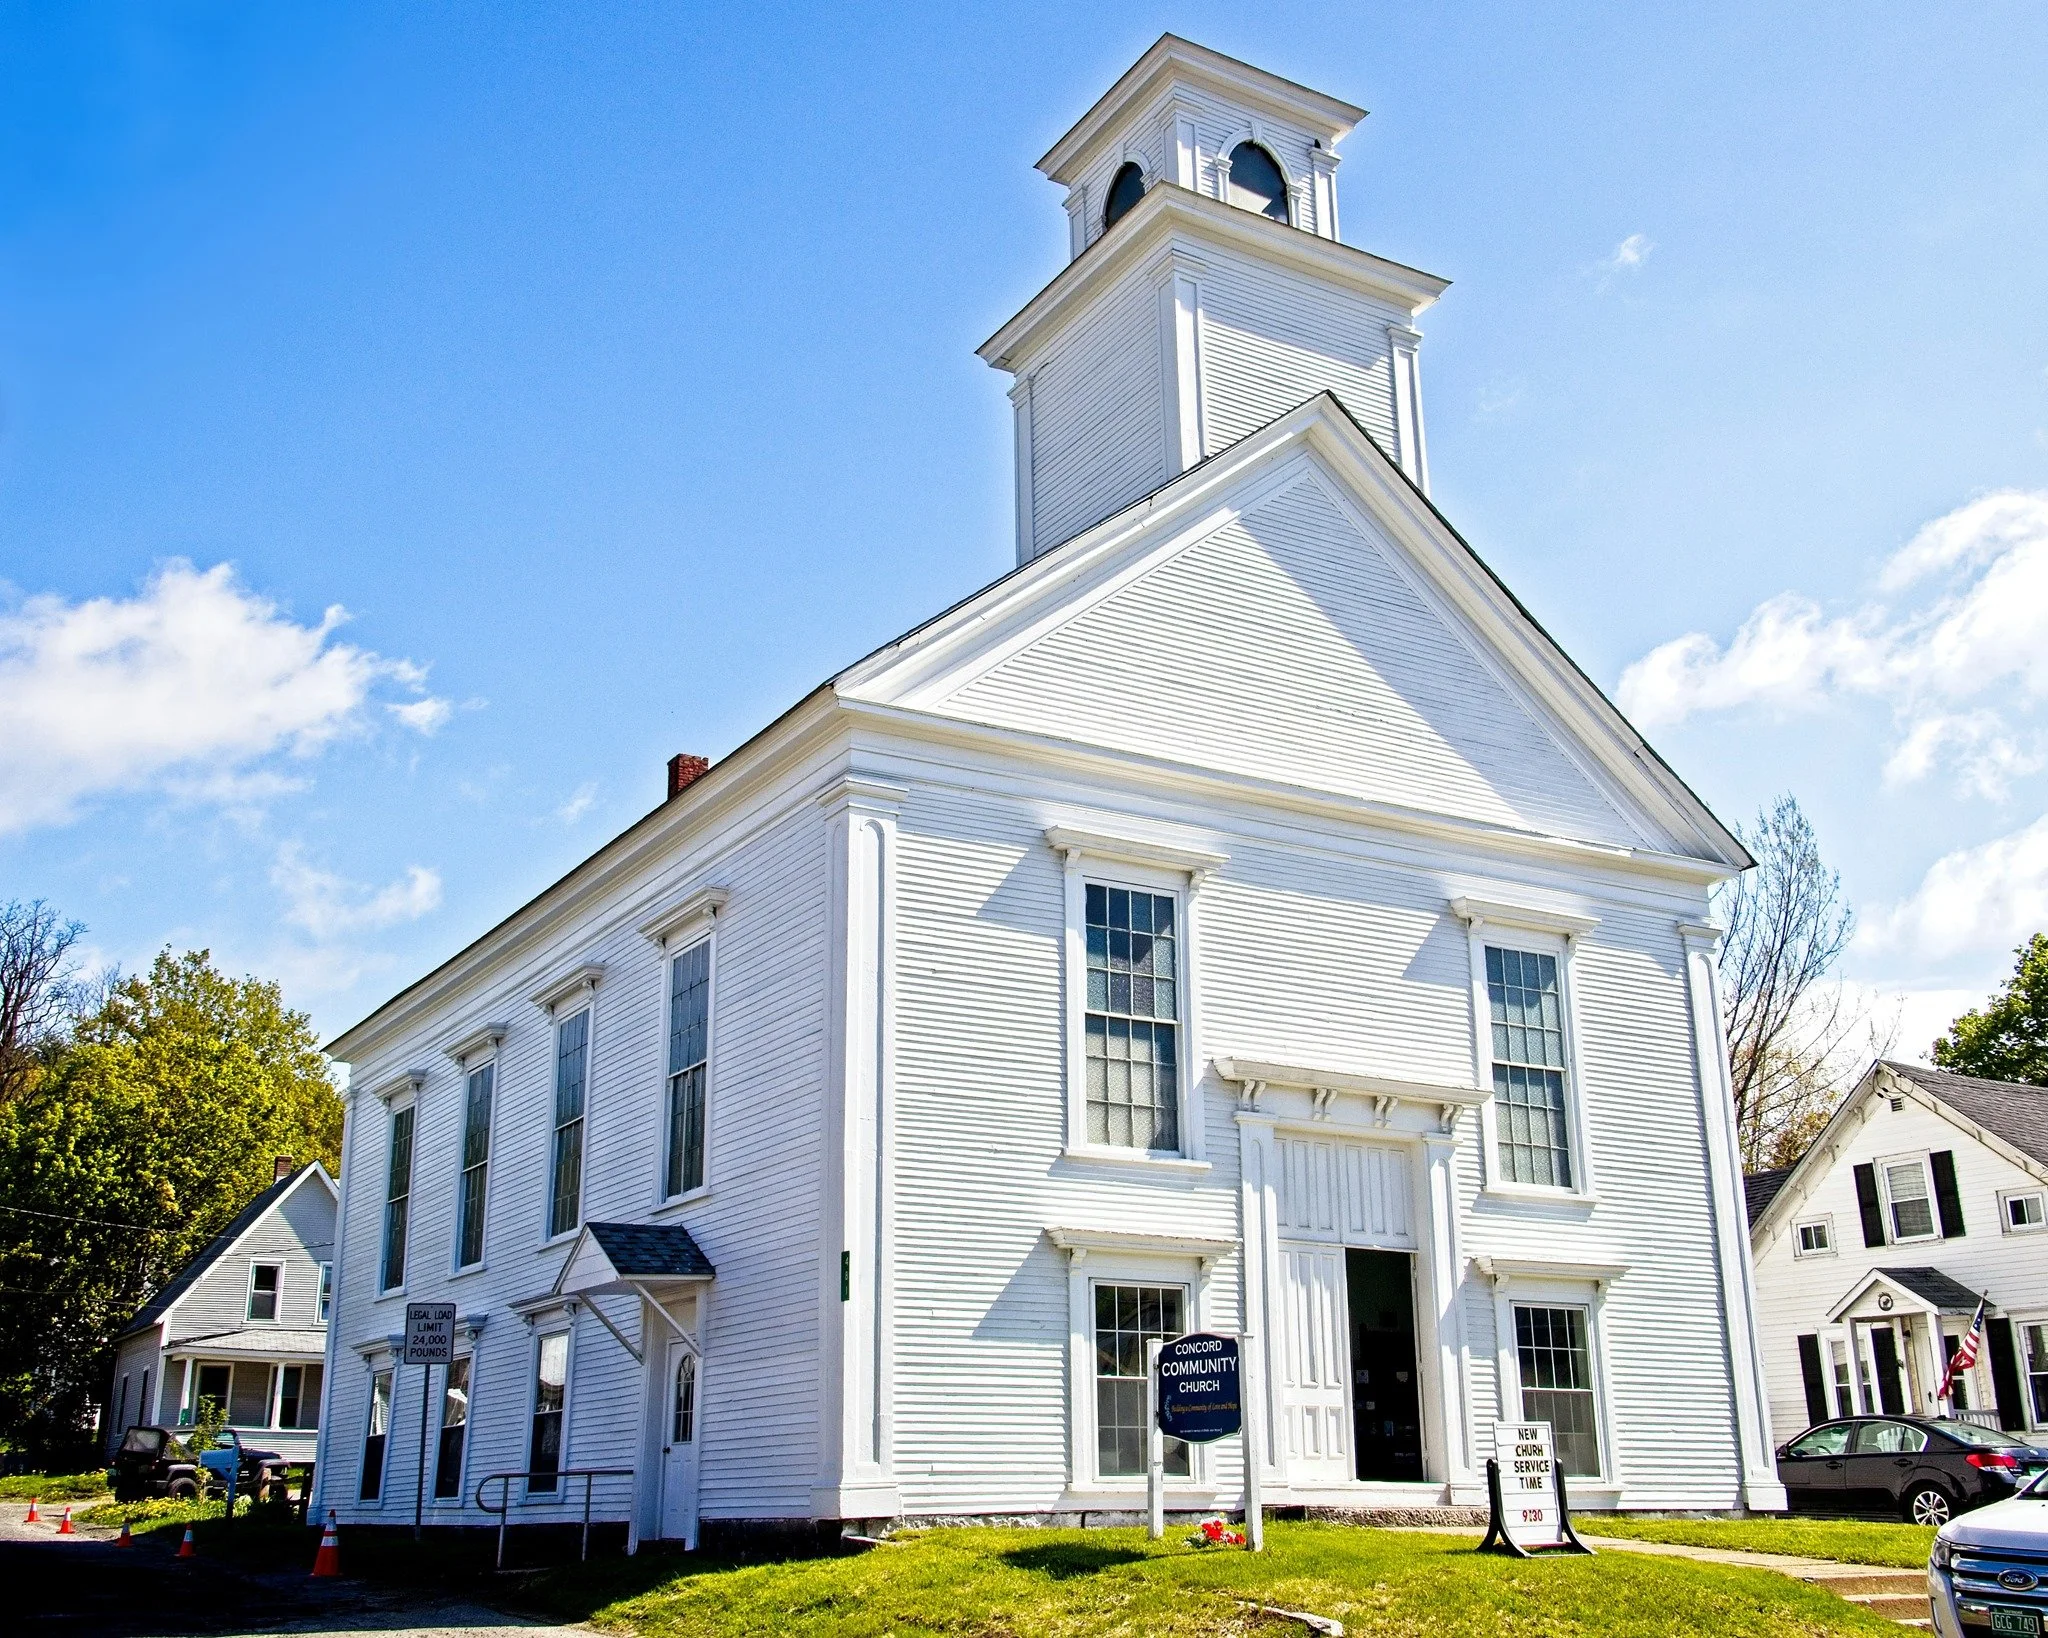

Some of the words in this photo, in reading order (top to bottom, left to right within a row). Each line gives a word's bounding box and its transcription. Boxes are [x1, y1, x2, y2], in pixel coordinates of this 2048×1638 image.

[409, 1310, 431, 1320] LEGAL
[434, 1310, 453, 1320] LOAD
[417, 1322, 443, 1332] LIMIT
[412, 1335, 447, 1346] 24,000
[409, 1347, 448, 1357] POUNDS
[1175, 1340, 1222, 1355] CONCORD
[1162, 1357, 1237, 1376] COMMUNITY
[1179, 1380, 1220, 1393] CHURCH
[1188, 1403, 1207, 1414] Community
[1518, 1428, 1538, 1441] NEW
[1515, 1444, 1544, 1457] CHURH
[1514, 1460, 1550, 1473] SERVICE
[1519, 1477, 1543, 1489] TIME
[1522, 1509, 1543, 1522] 9:30
[2004, 1574, 2025, 1584] Ford
[1994, 1614, 2013, 1630] GCG
[2017, 1616, 2035, 1632] 749
